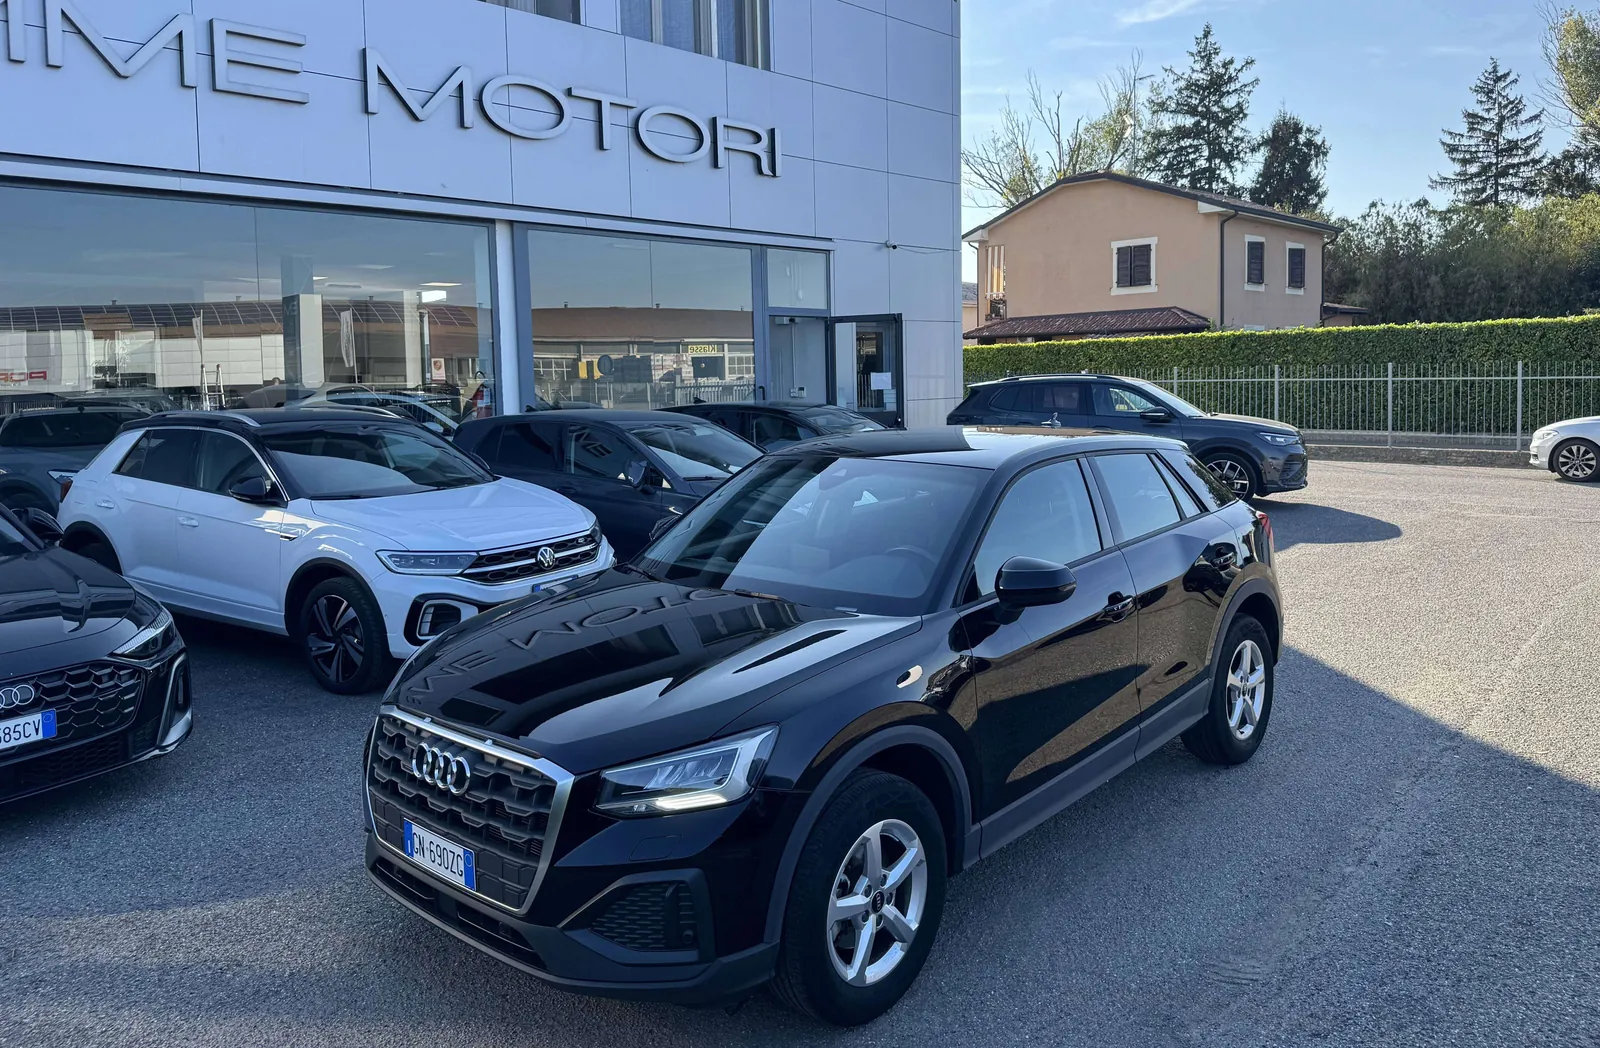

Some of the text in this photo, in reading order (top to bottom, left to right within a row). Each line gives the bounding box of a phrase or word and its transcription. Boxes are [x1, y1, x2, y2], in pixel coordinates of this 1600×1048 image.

[0, 0, 782, 178] ME MOTORI
[0, 718, 41, 744] 85CV
